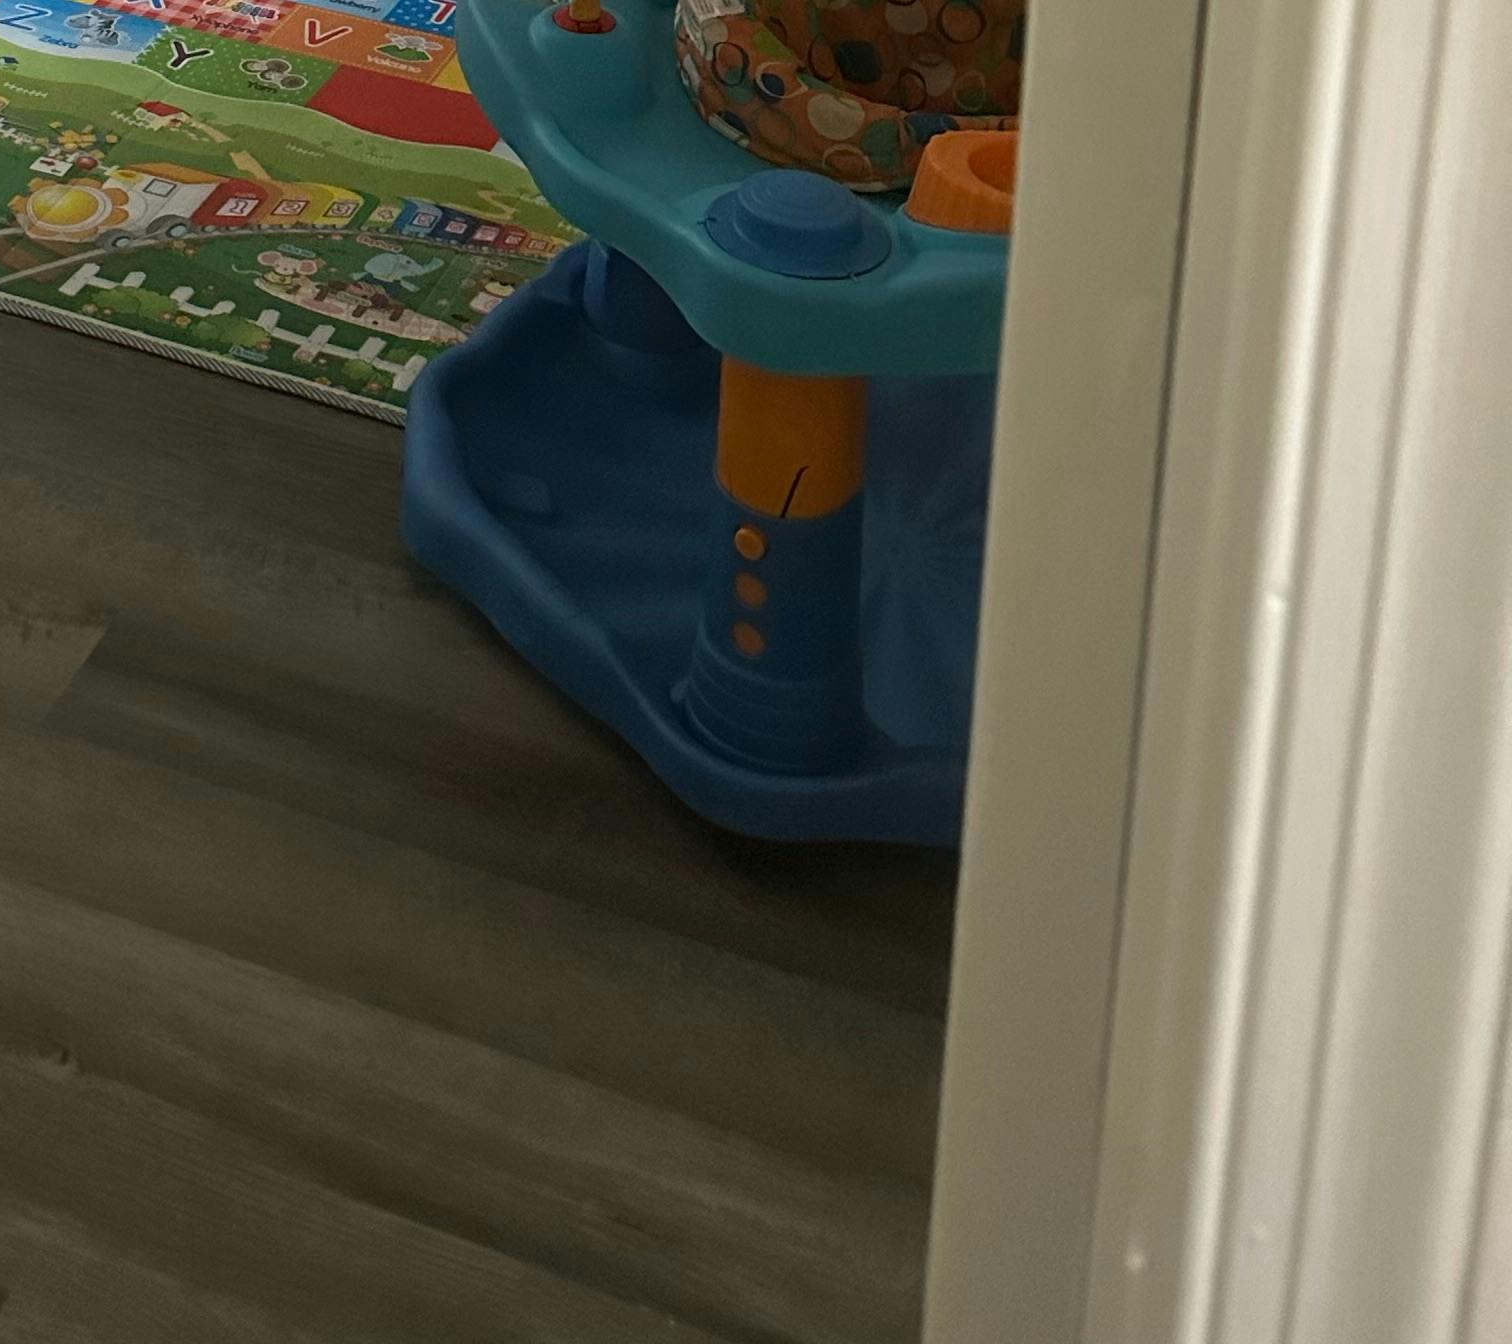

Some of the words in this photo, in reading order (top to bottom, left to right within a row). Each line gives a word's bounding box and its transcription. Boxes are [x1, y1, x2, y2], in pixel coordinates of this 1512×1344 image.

[38, 33, 81, 50] Zebra
[304, 17, 354, 48] V
[167, 38, 215, 71] Y
